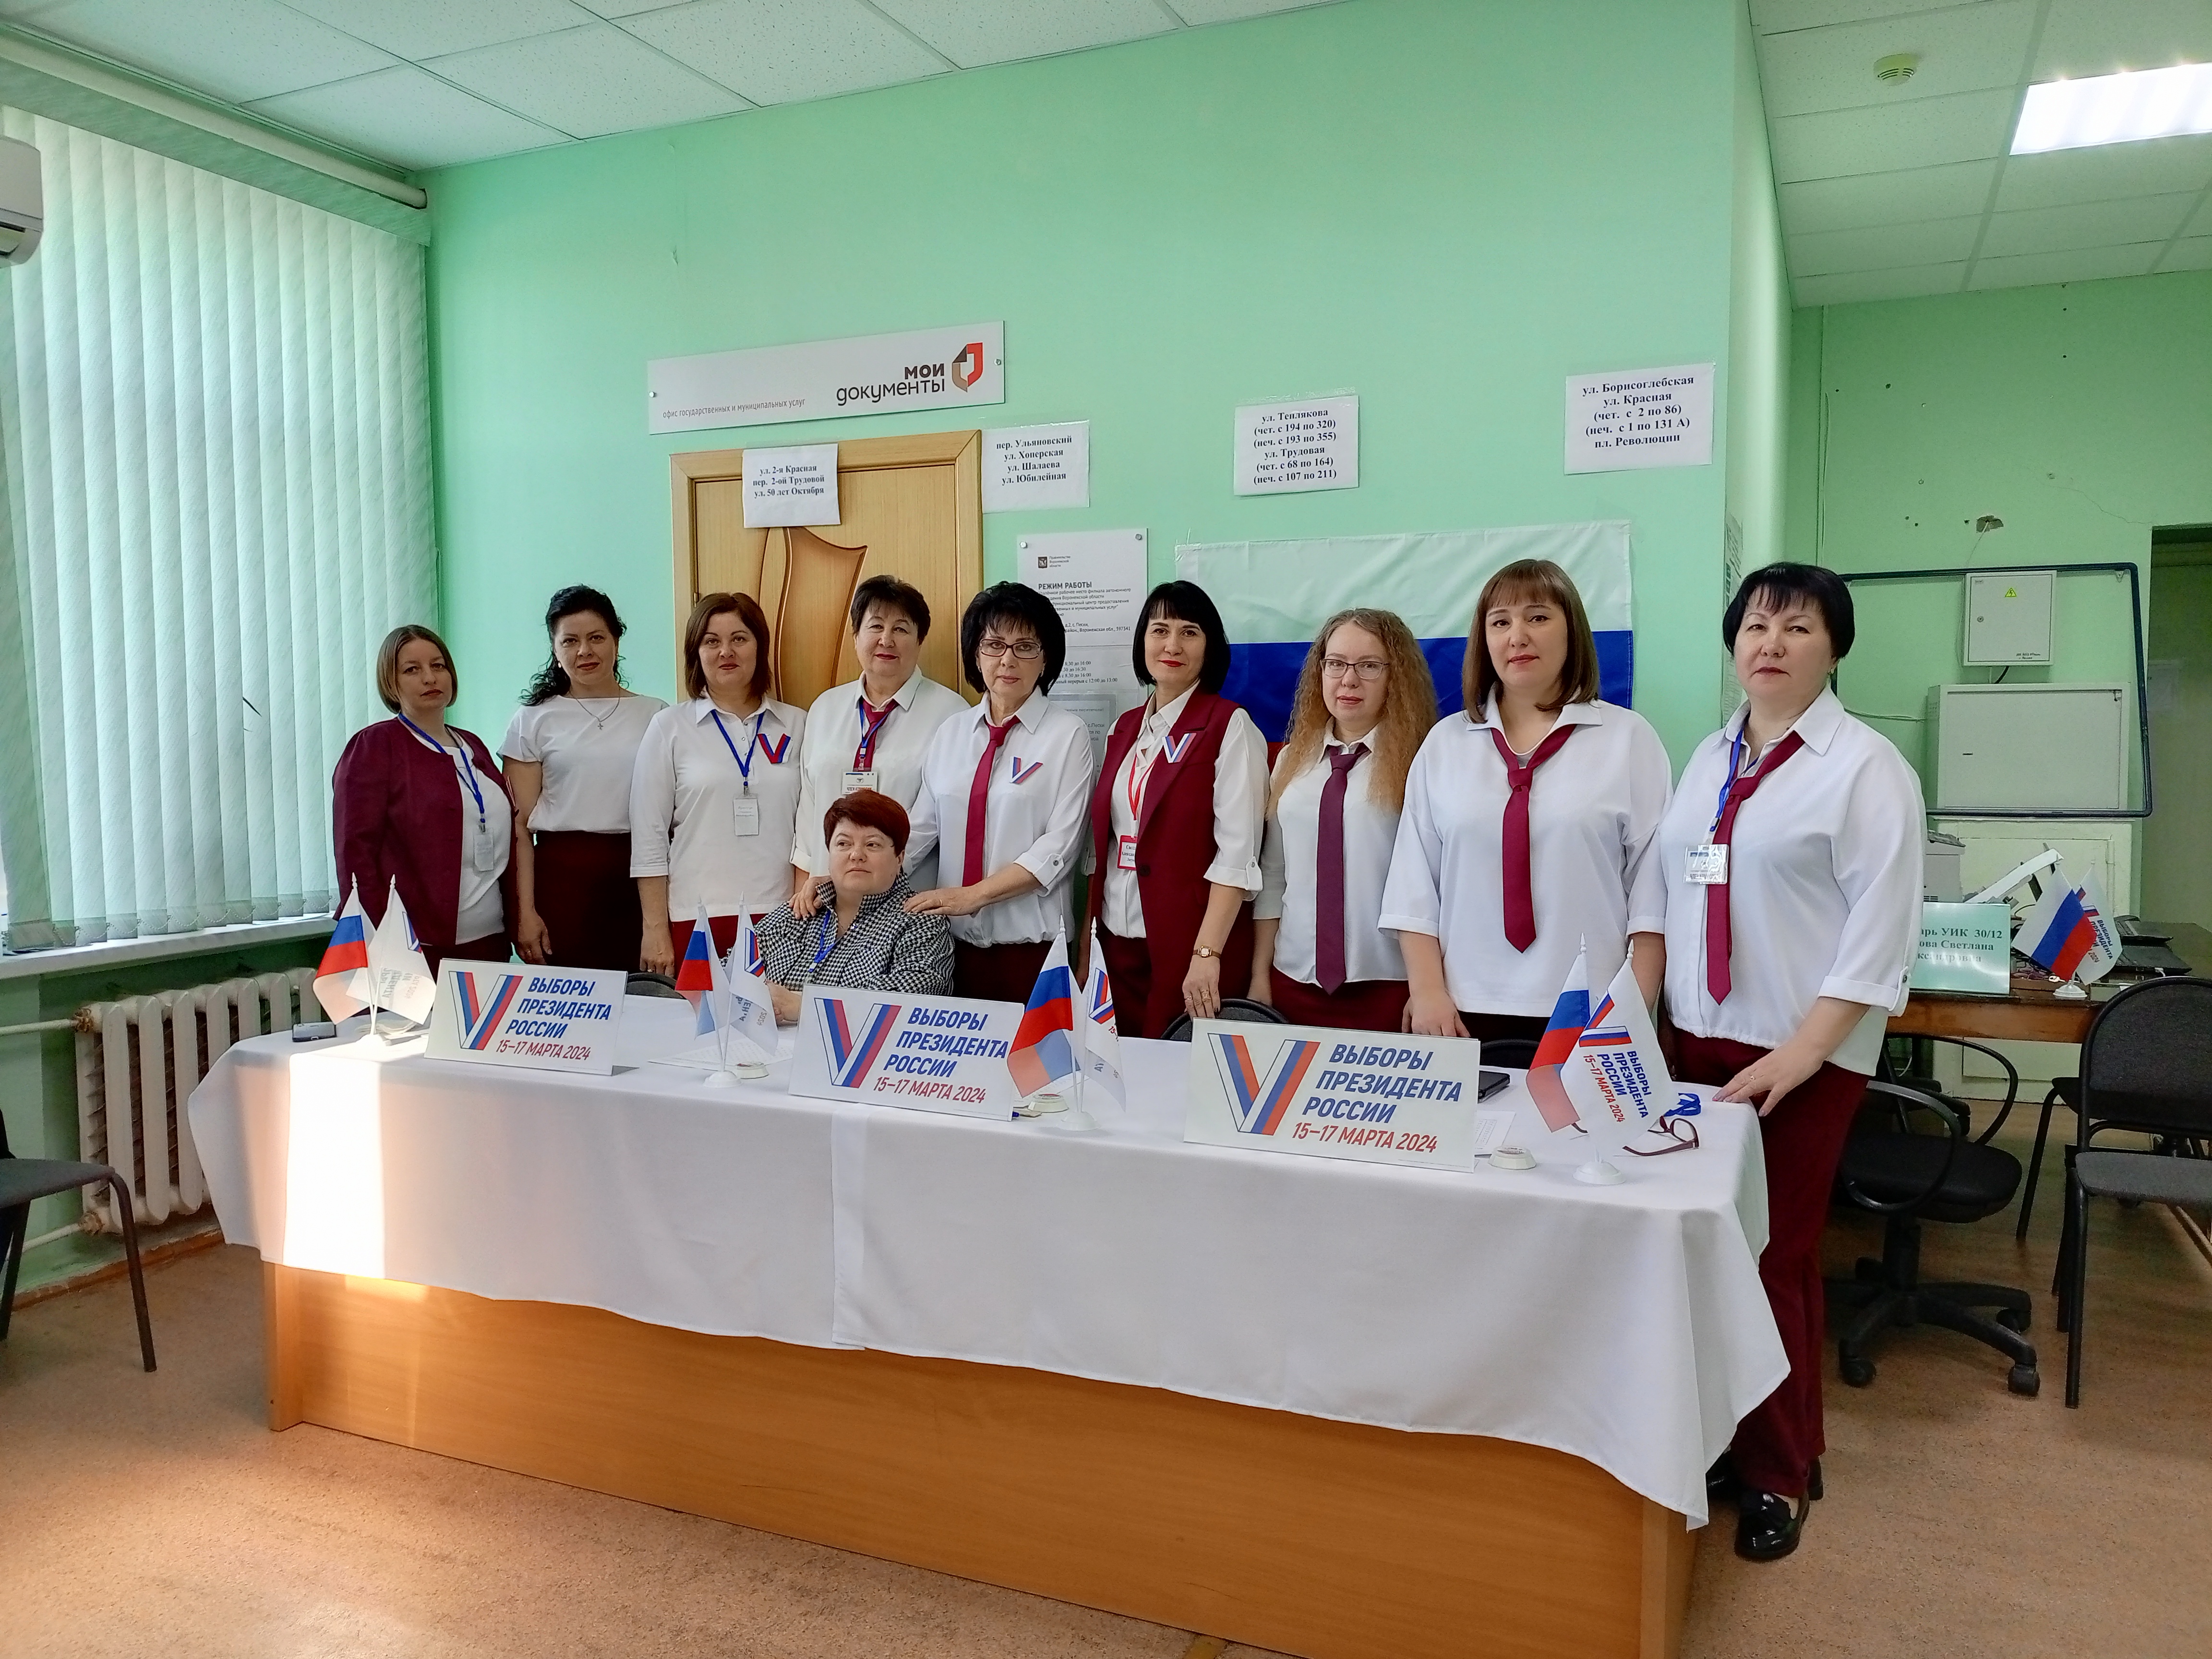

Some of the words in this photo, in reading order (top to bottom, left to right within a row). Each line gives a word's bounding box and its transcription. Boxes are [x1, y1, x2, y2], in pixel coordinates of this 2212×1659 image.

[904, 363, 944, 379] мои
[836, 378, 945, 406] документы
[1582, 386, 1599, 397] ул.
[1602, 376, 1694, 393] Борисоглебская
[663, 410, 678, 419] офис
[679, 406, 730, 418] государственных
[737, 400, 787, 412] муниципальных
[789, 398, 805, 409] услуг
[1603, 398, 1620, 408] ул.
[1623, 393, 1672, 406] Красная
[1262, 416, 1275, 424] ул.
[1278, 409, 1328, 421] Теплякова
[1594, 412, 1620, 422] (чет.
[1638, 408, 1644, 417] 2
[1664, 404, 1682, 415] 86)
[1254, 427, 1275, 437] (чет.
[1286, 422, 1300, 432] 194
[1317, 419, 1336, 430] 320)
[1586, 426, 1612, 437] (неч.
[1628, 422, 1633, 431] 1
[1637, 422, 1650, 431] по
[1655, 419, 1672, 429] 131
[996, 442, 1013, 450] пер.
[1015, 435, 1072, 448] Ульяновский
[1254, 439, 1275, 449] (неч.
[1286, 434, 1300, 444] 193
[1317, 432, 1336, 441] 355)
[1595, 440, 1612, 448] пл.
[1615, 433, 1680, 447] Революции
[1004, 454, 1016, 462] ул.
[1019, 449, 1063, 459] Хоперская
[1264, 452, 1278, 460] ул.
[1280, 446, 1325, 458] Трудовая
[785, 465, 817, 474] Красная
[1008, 465, 1020, 473] ул.
[1022, 462, 1060, 470] Шалаева
[1256, 463, 1278, 473] (чет.
[1287, 459, 1298, 469] 68
[1315, 457, 1334, 466] 164)
[789, 475, 825, 485] Трудовой
[1002, 477, 1014, 486] ул.
[1017, 472, 1066, 483] Юбилейная
[1254, 475, 1276, 485] (неч.
[1286, 472, 1300, 481] 107
[1317, 469, 1337, 479] 211)
[754, 491, 766, 499] ул.
[792, 486, 824, 495] Октября
[1941, 927, 1969, 937] УИК
[1974, 929, 2002, 939] 30/12
[1941, 939, 1994, 950] Светлана
[528, 977, 596, 997] ВЫБОРЫ
[517, 998, 613, 1021] ПРЕЗИДЕНТА
[907, 1007, 988, 1031] ВЫБОРЫ
[505, 1019, 568, 1039] РОССИИ
[527, 1042, 564, 1058] МАРТА
[562, 1045, 591, 1061] 2024
[896, 1031, 1009, 1059] ПРЕЗИДЕНТА
[883, 1054, 958, 1078] РОССИИ
[1329, 1044, 1434, 1071] ВЫБОРЫ
[1597, 1053, 1627, 1096] РОССИИ
[1626, 1050, 1652, 1096] ВЫБОРЫ
[908, 1080, 954, 1100] МАРТА
[952, 1085, 986, 1104] 2024
[1315, 1070, 1463, 1102] ПРЕЗИДЕНТА
[1613, 1052, 1649, 1118] ПРЕЗИДЕНТА
[1595, 1077, 1616, 1103] МАРТА
[1609, 1104, 1625, 1123] 2024
[1302, 1096, 1397, 1124] РОССИИ
[1337, 1126, 1396, 1149] МАРТА
[1395, 1132, 1438, 1153] 2024
